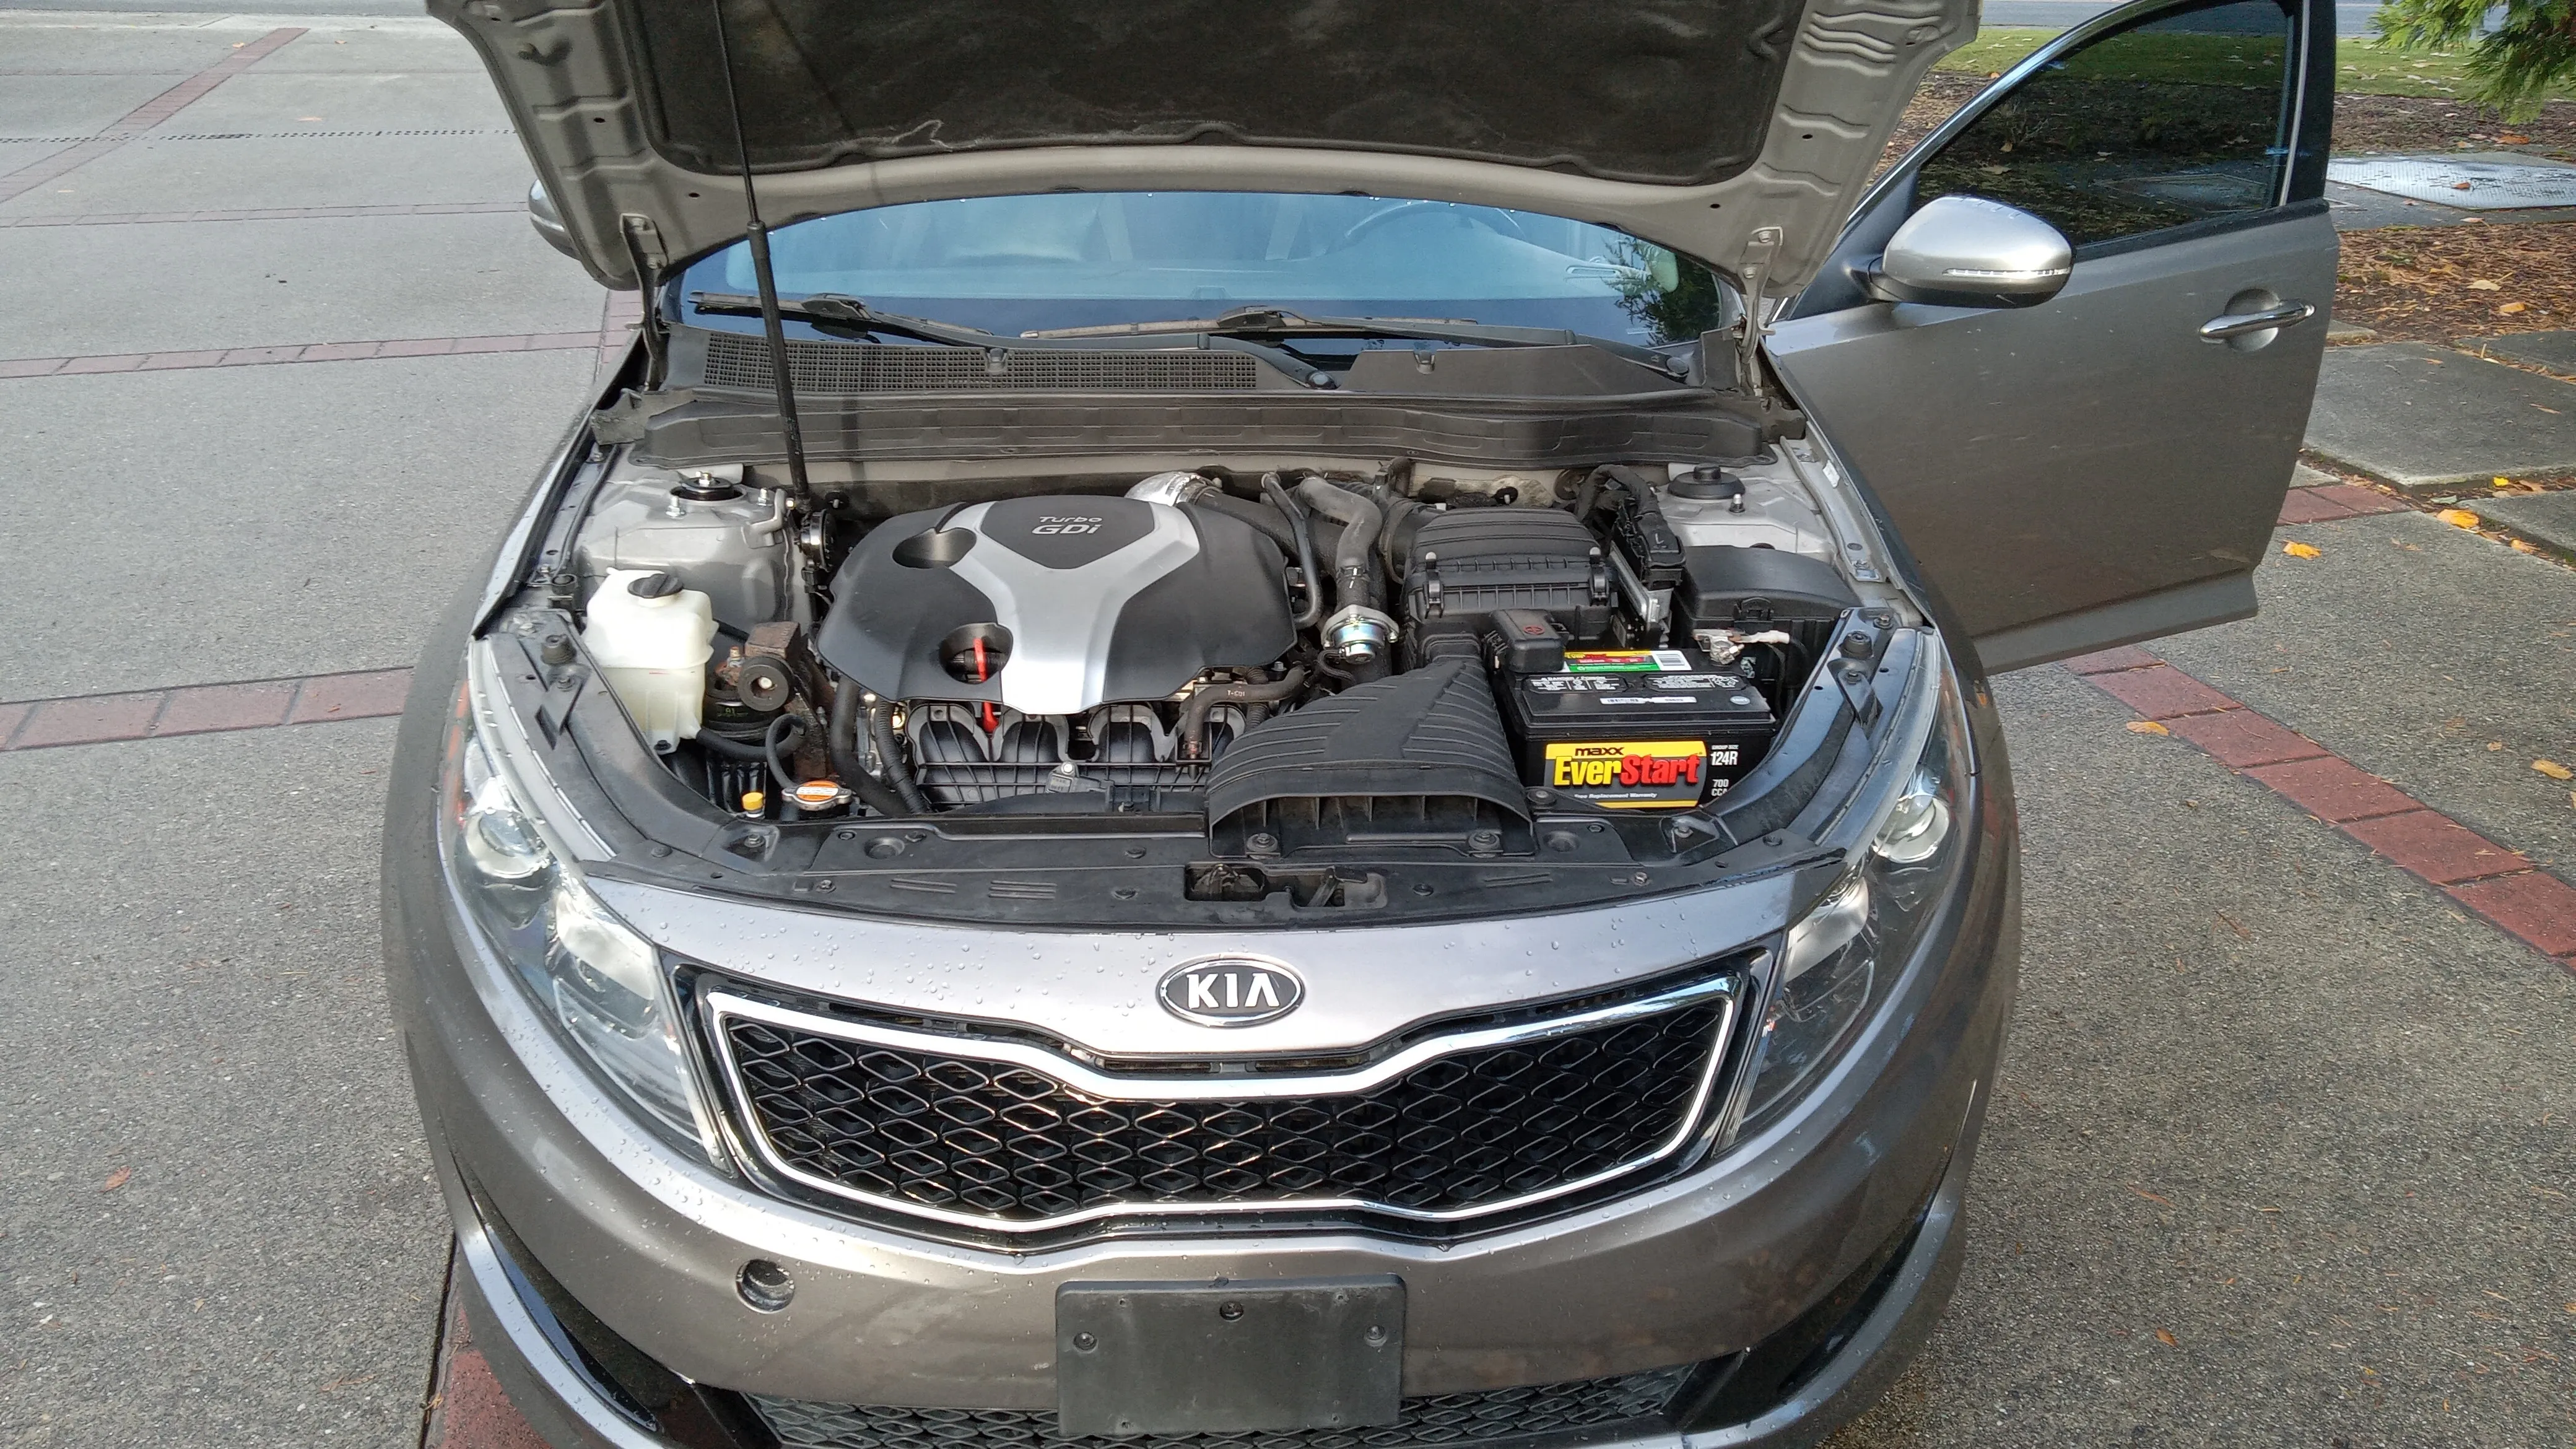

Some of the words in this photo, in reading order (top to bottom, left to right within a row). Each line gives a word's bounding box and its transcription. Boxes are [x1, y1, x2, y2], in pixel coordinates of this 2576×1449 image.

[1032, 524, 1102, 534] GDi
[1575, 747, 1625, 756] maxx
[1710, 751, 1739, 766] 124R
[1554, 753, 1701, 786] EverStart
[1712, 778, 1730, 788] 700
[1186, 972, 1281, 1009] KIA
